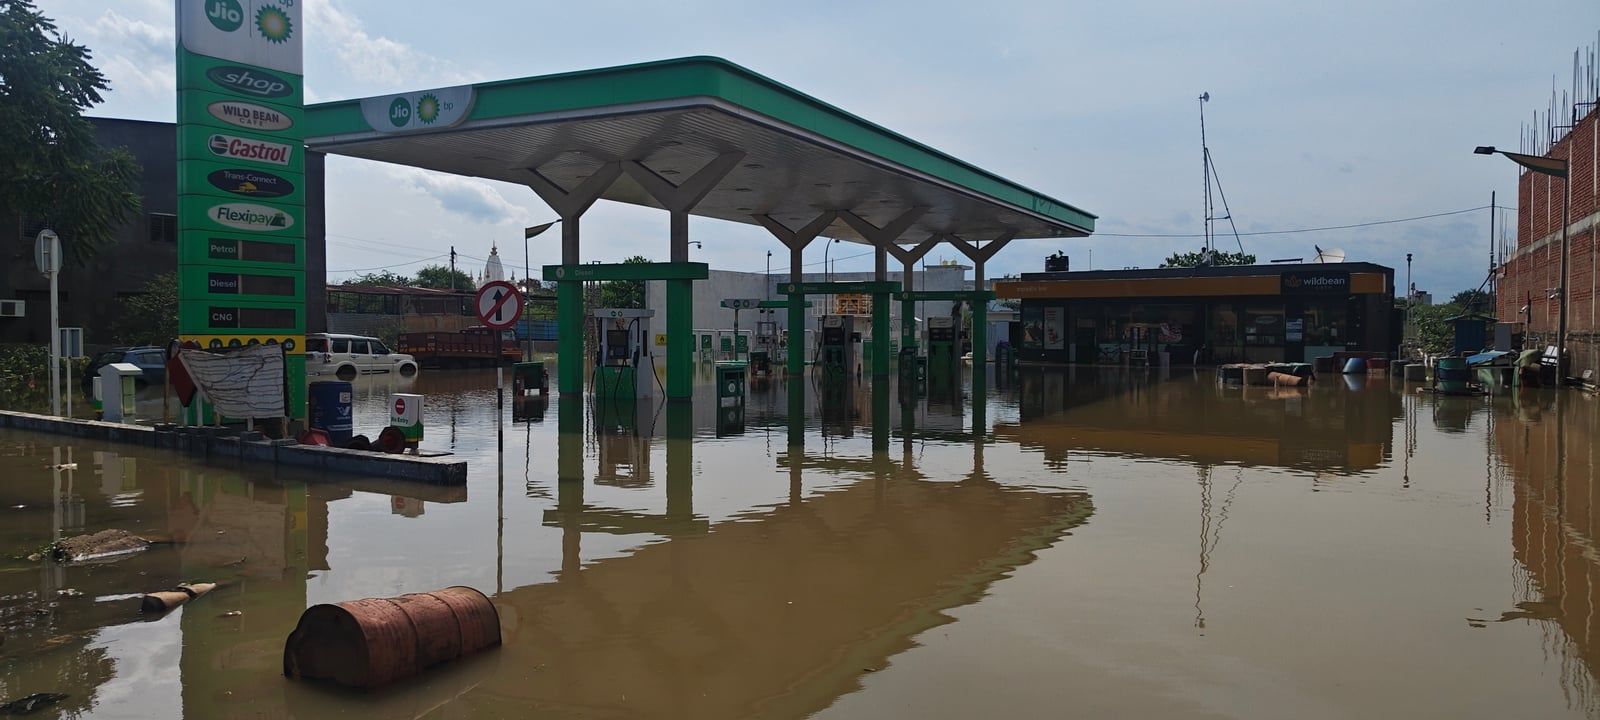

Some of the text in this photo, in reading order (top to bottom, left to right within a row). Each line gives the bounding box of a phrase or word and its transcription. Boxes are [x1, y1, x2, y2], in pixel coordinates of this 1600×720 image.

[209, 2, 241, 23] Jio
[225, 72, 284, 94] shop
[392, 104, 409, 118] Jio
[443, 102, 454, 111] bp
[223, 105, 279, 123] WILD BEAN
[229, 139, 287, 162] Castrol
[224, 171, 277, 184] Trans-Connect
[217, 207, 272, 226] Flexipay
[210, 244, 236, 253] Petrol
[210, 279, 237, 288] Diesel
[1303, 276, 1345, 285] wildbean
[212, 313, 233, 321] CNG
